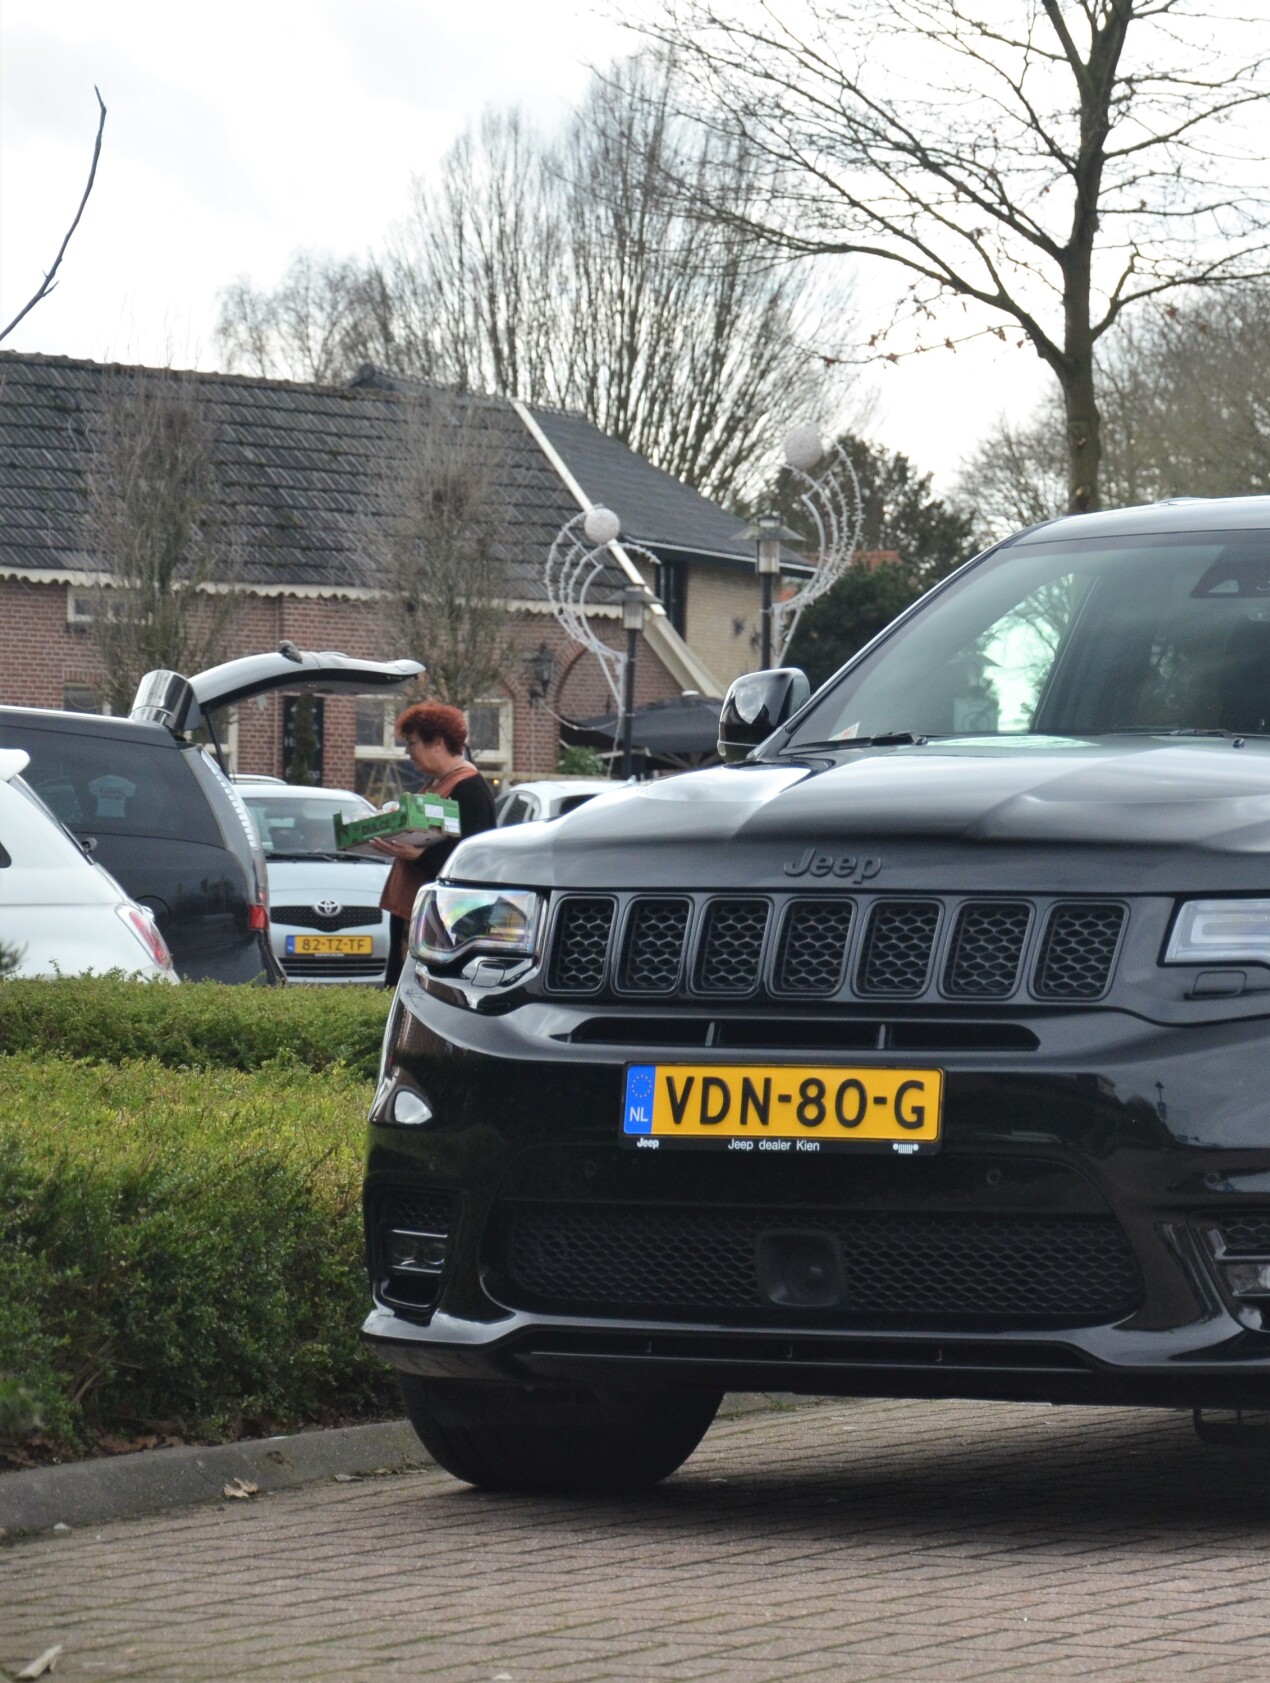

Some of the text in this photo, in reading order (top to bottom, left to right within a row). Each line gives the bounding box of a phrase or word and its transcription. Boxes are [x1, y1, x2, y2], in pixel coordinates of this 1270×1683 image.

[784, 849, 882, 884] Jeep
[302, 939, 365, 951] 82-TZ-TF
[665, 1076, 926, 1130] VDN-80-G
[629, 1106, 649, 1123] NL
[636, 1138, 660, 1149] Jeep
[727, 1138, 820, 1152] Jeep dealer Kien
